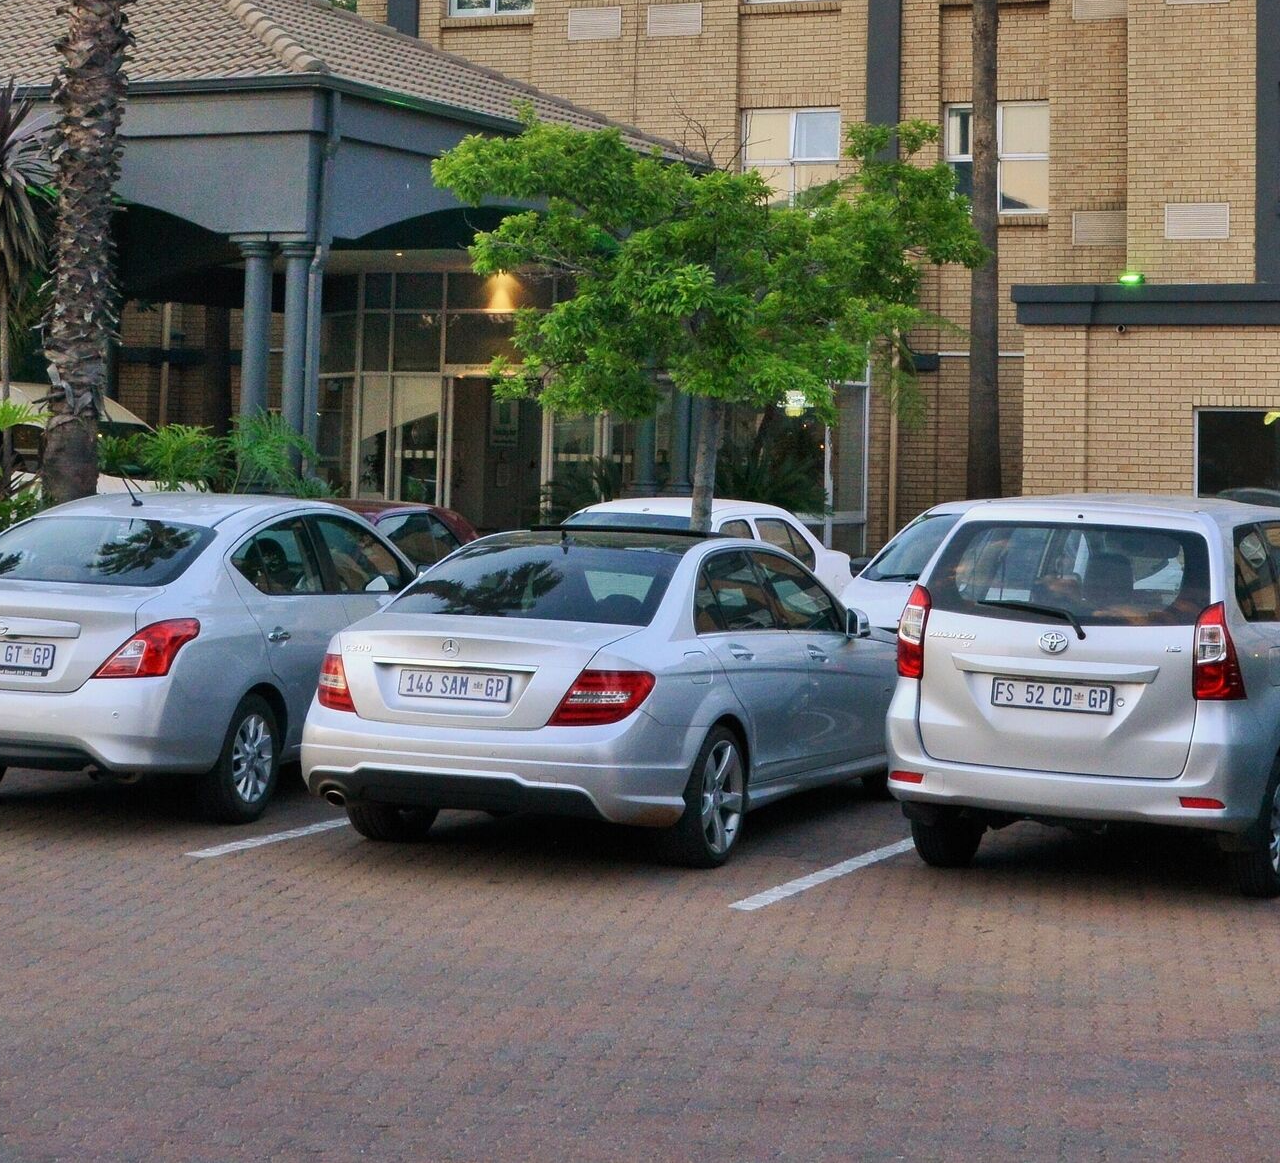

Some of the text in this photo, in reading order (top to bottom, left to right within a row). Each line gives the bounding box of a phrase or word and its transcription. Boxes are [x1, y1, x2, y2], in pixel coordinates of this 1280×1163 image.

[4, 645, 22, 663] GT
[32, 647, 51, 665] GP
[406, 673, 505, 698] 146 SAM GP
[994, 682, 1109, 710] FS 52 CD GP
